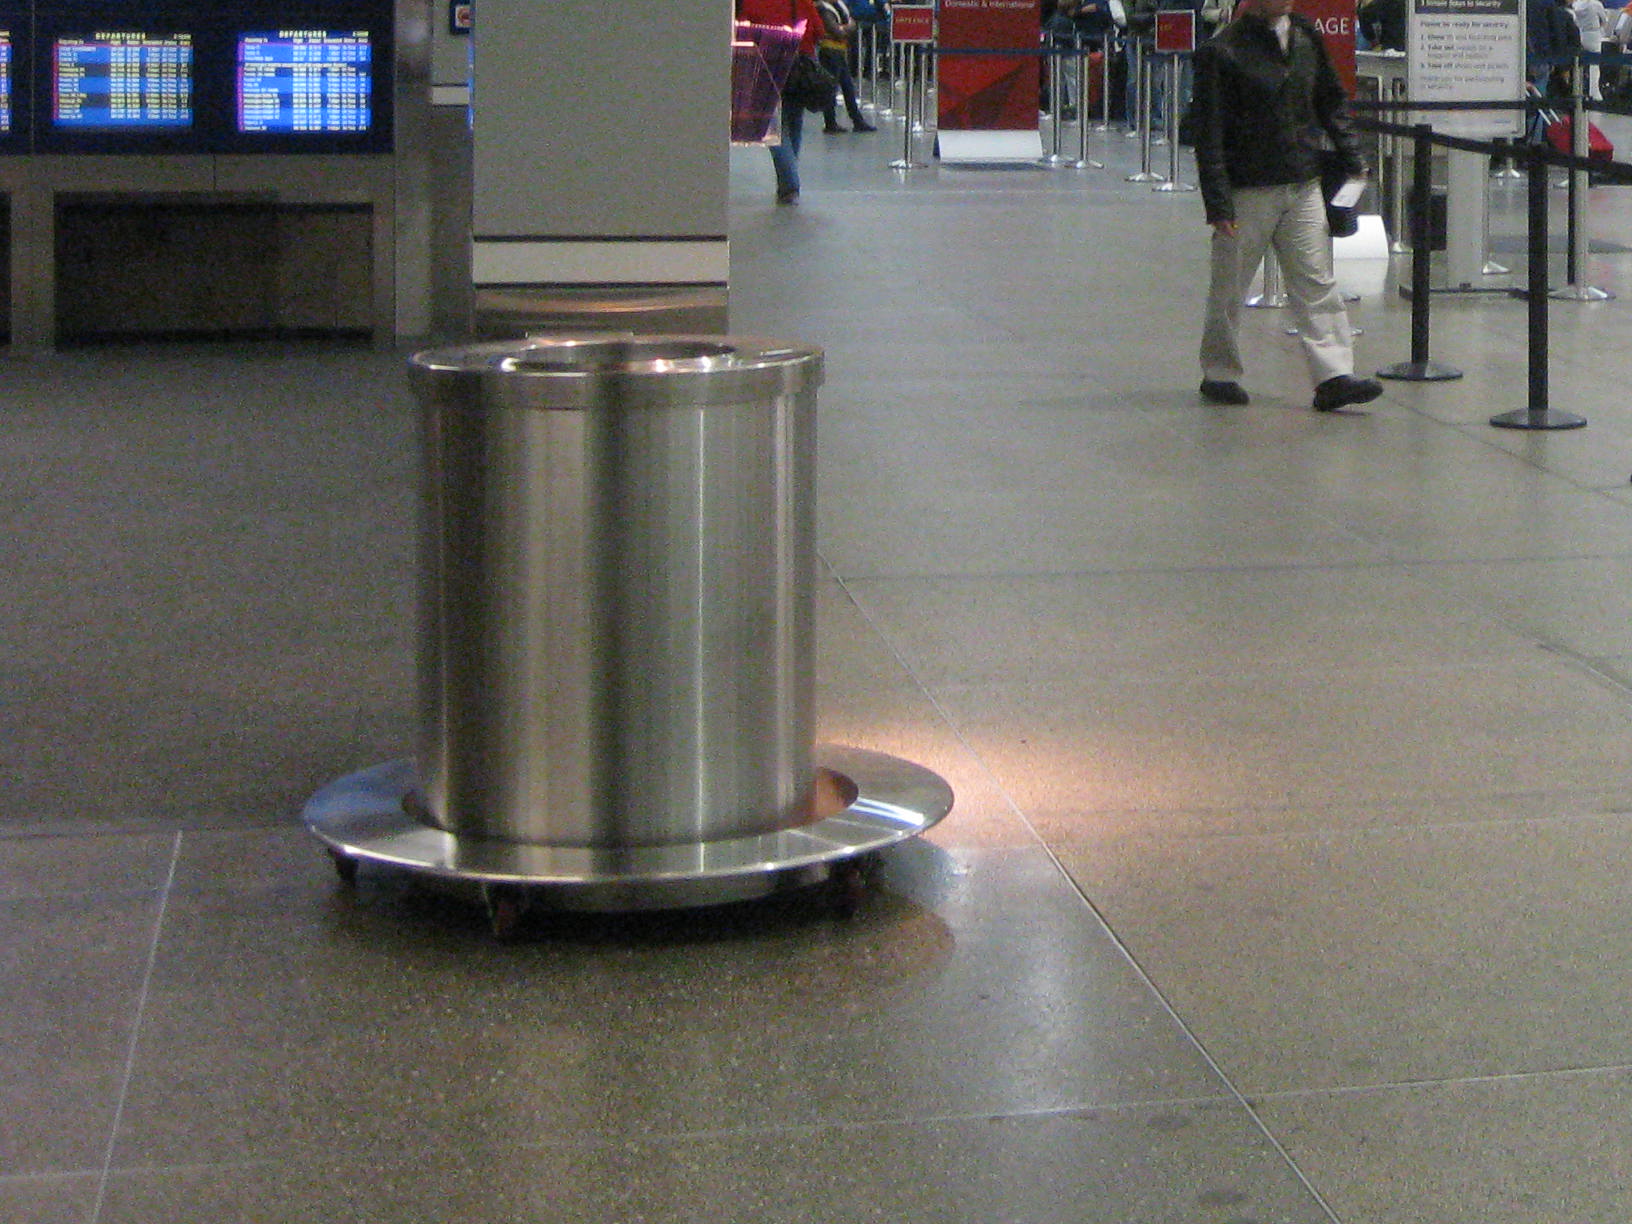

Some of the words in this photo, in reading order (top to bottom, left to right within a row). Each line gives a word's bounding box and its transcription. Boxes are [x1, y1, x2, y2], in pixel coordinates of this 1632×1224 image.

[945, 0, 980, 8] Domestic
[989, 0, 1035, 8] International
[95, 32, 146, 40] DEPARTURES
[279, 30, 327, 38] DEPARTURES
